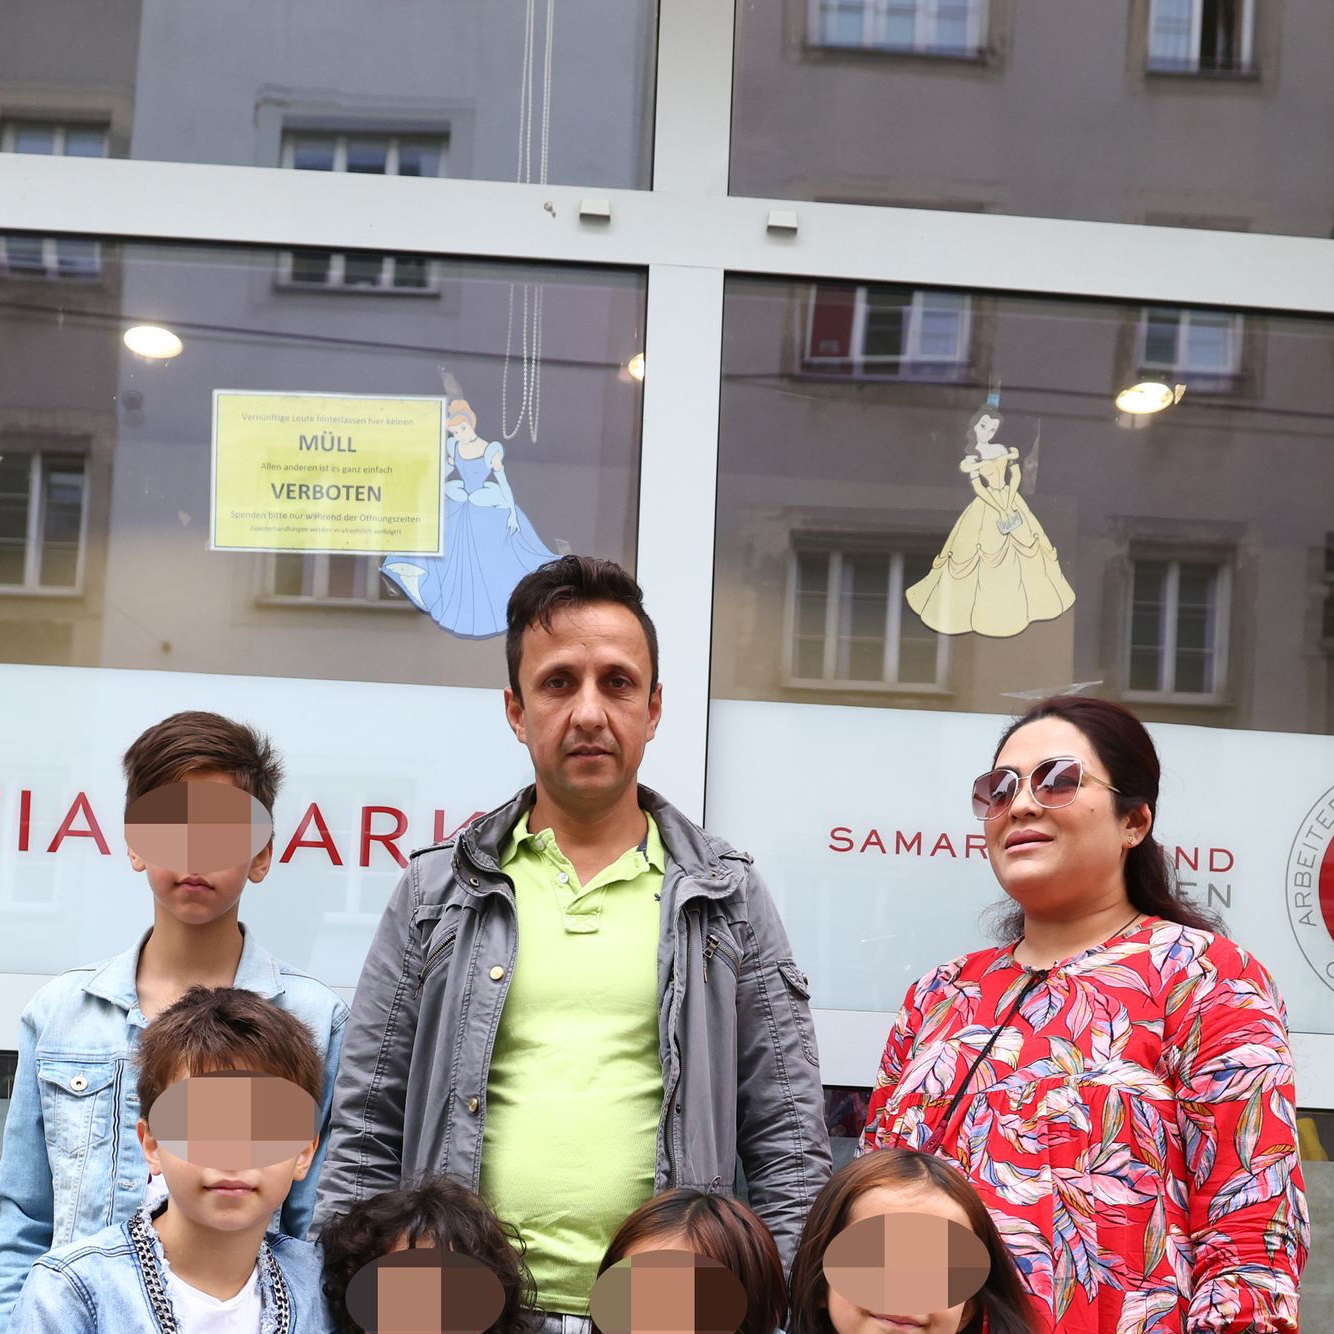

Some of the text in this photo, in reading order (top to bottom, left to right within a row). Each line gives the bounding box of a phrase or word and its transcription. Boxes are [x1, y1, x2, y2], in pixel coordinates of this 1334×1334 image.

[298, 430, 357, 453] MÜLL
[261, 462, 282, 471] Allen
[284, 463, 317, 472] anderen
[319, 464, 329, 472] ist
[342, 466, 361, 474] ganz
[363, 465, 393, 474] einfach
[270, 483, 382, 502] VERBOTEN
[230, 511, 267, 520] Spenden
[268, 511, 287, 519] bitte
[305, 512, 342, 521] während
[343, 513, 357, 521] der
